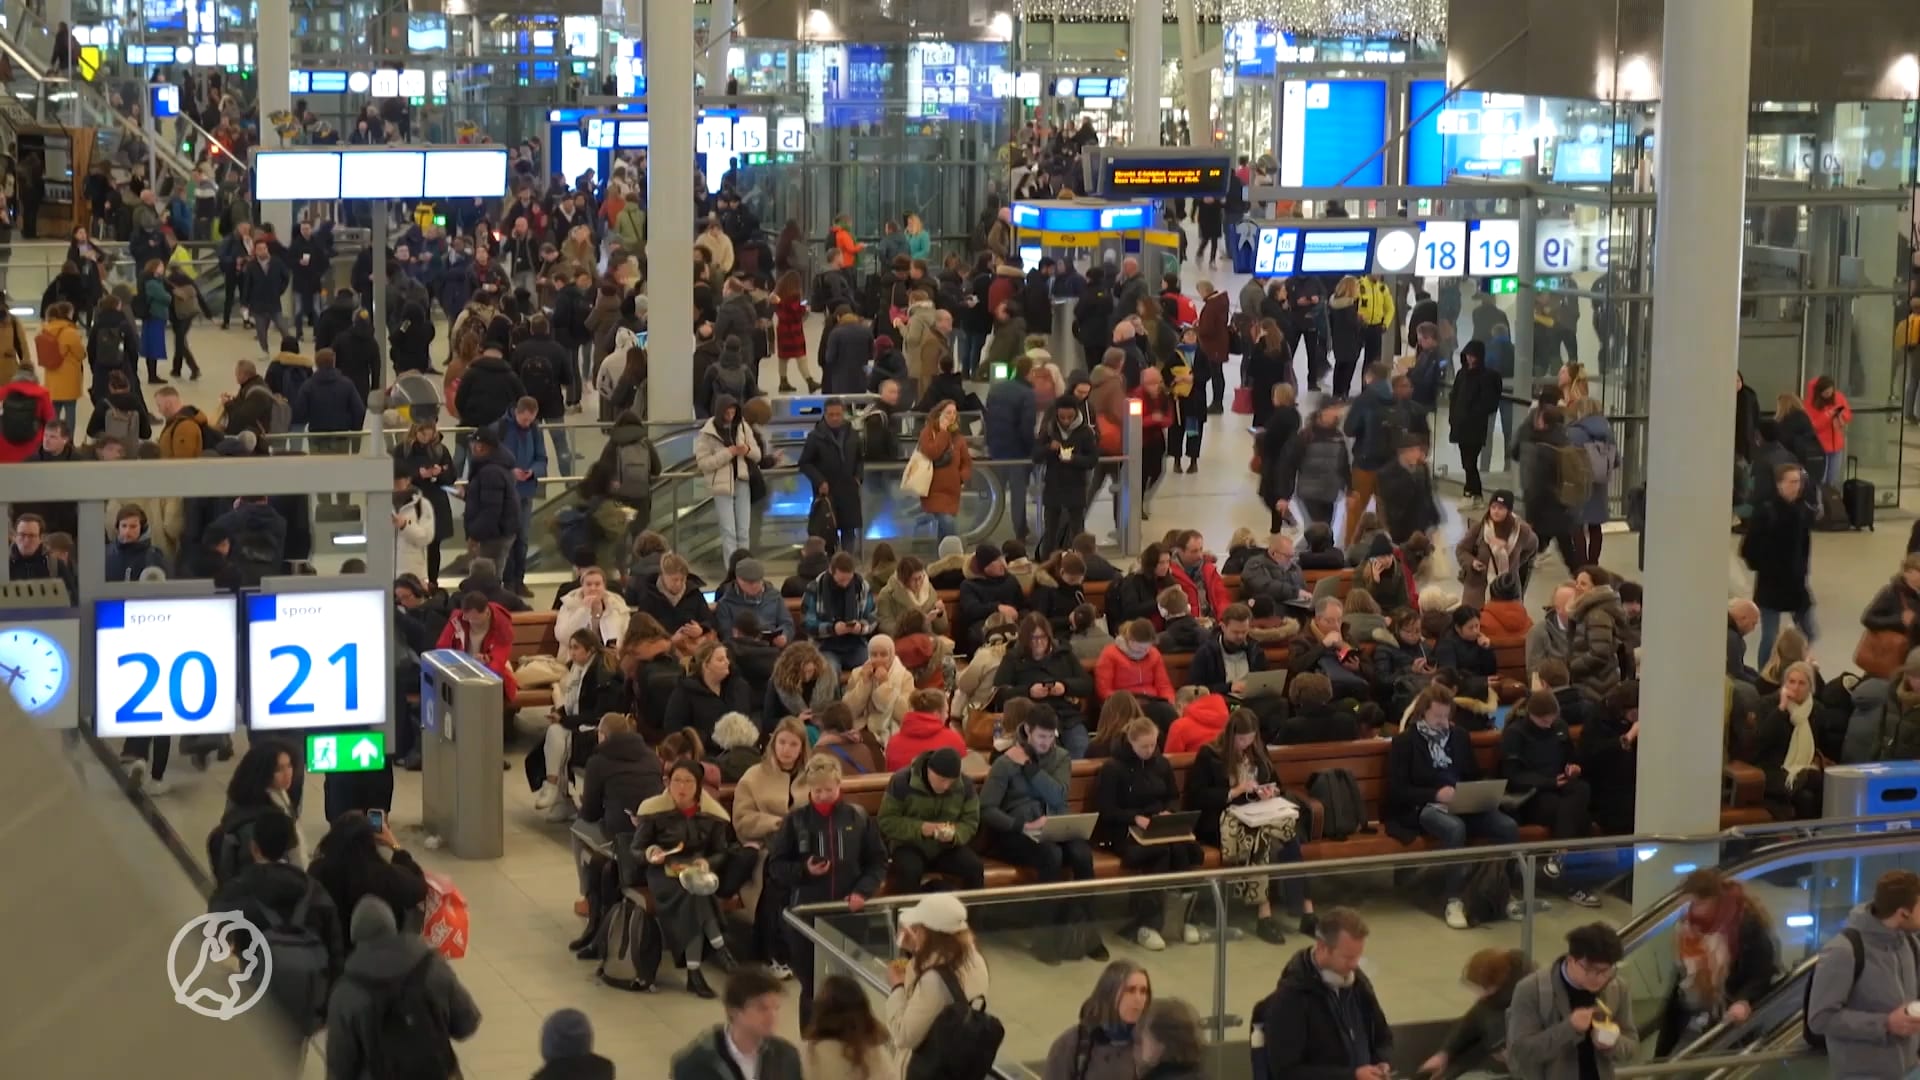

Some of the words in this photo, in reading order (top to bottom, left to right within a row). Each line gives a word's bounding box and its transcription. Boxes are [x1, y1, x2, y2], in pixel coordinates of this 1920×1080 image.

[742, 130, 760, 148] 15
[1425, 241, 1457, 271] 18
[1479, 239, 1510, 268] 19
[130, 612, 172, 626] spoor
[281, 604, 323, 618] spoor
[115, 650, 218, 723] 20
[268, 642, 359, 716] 21
